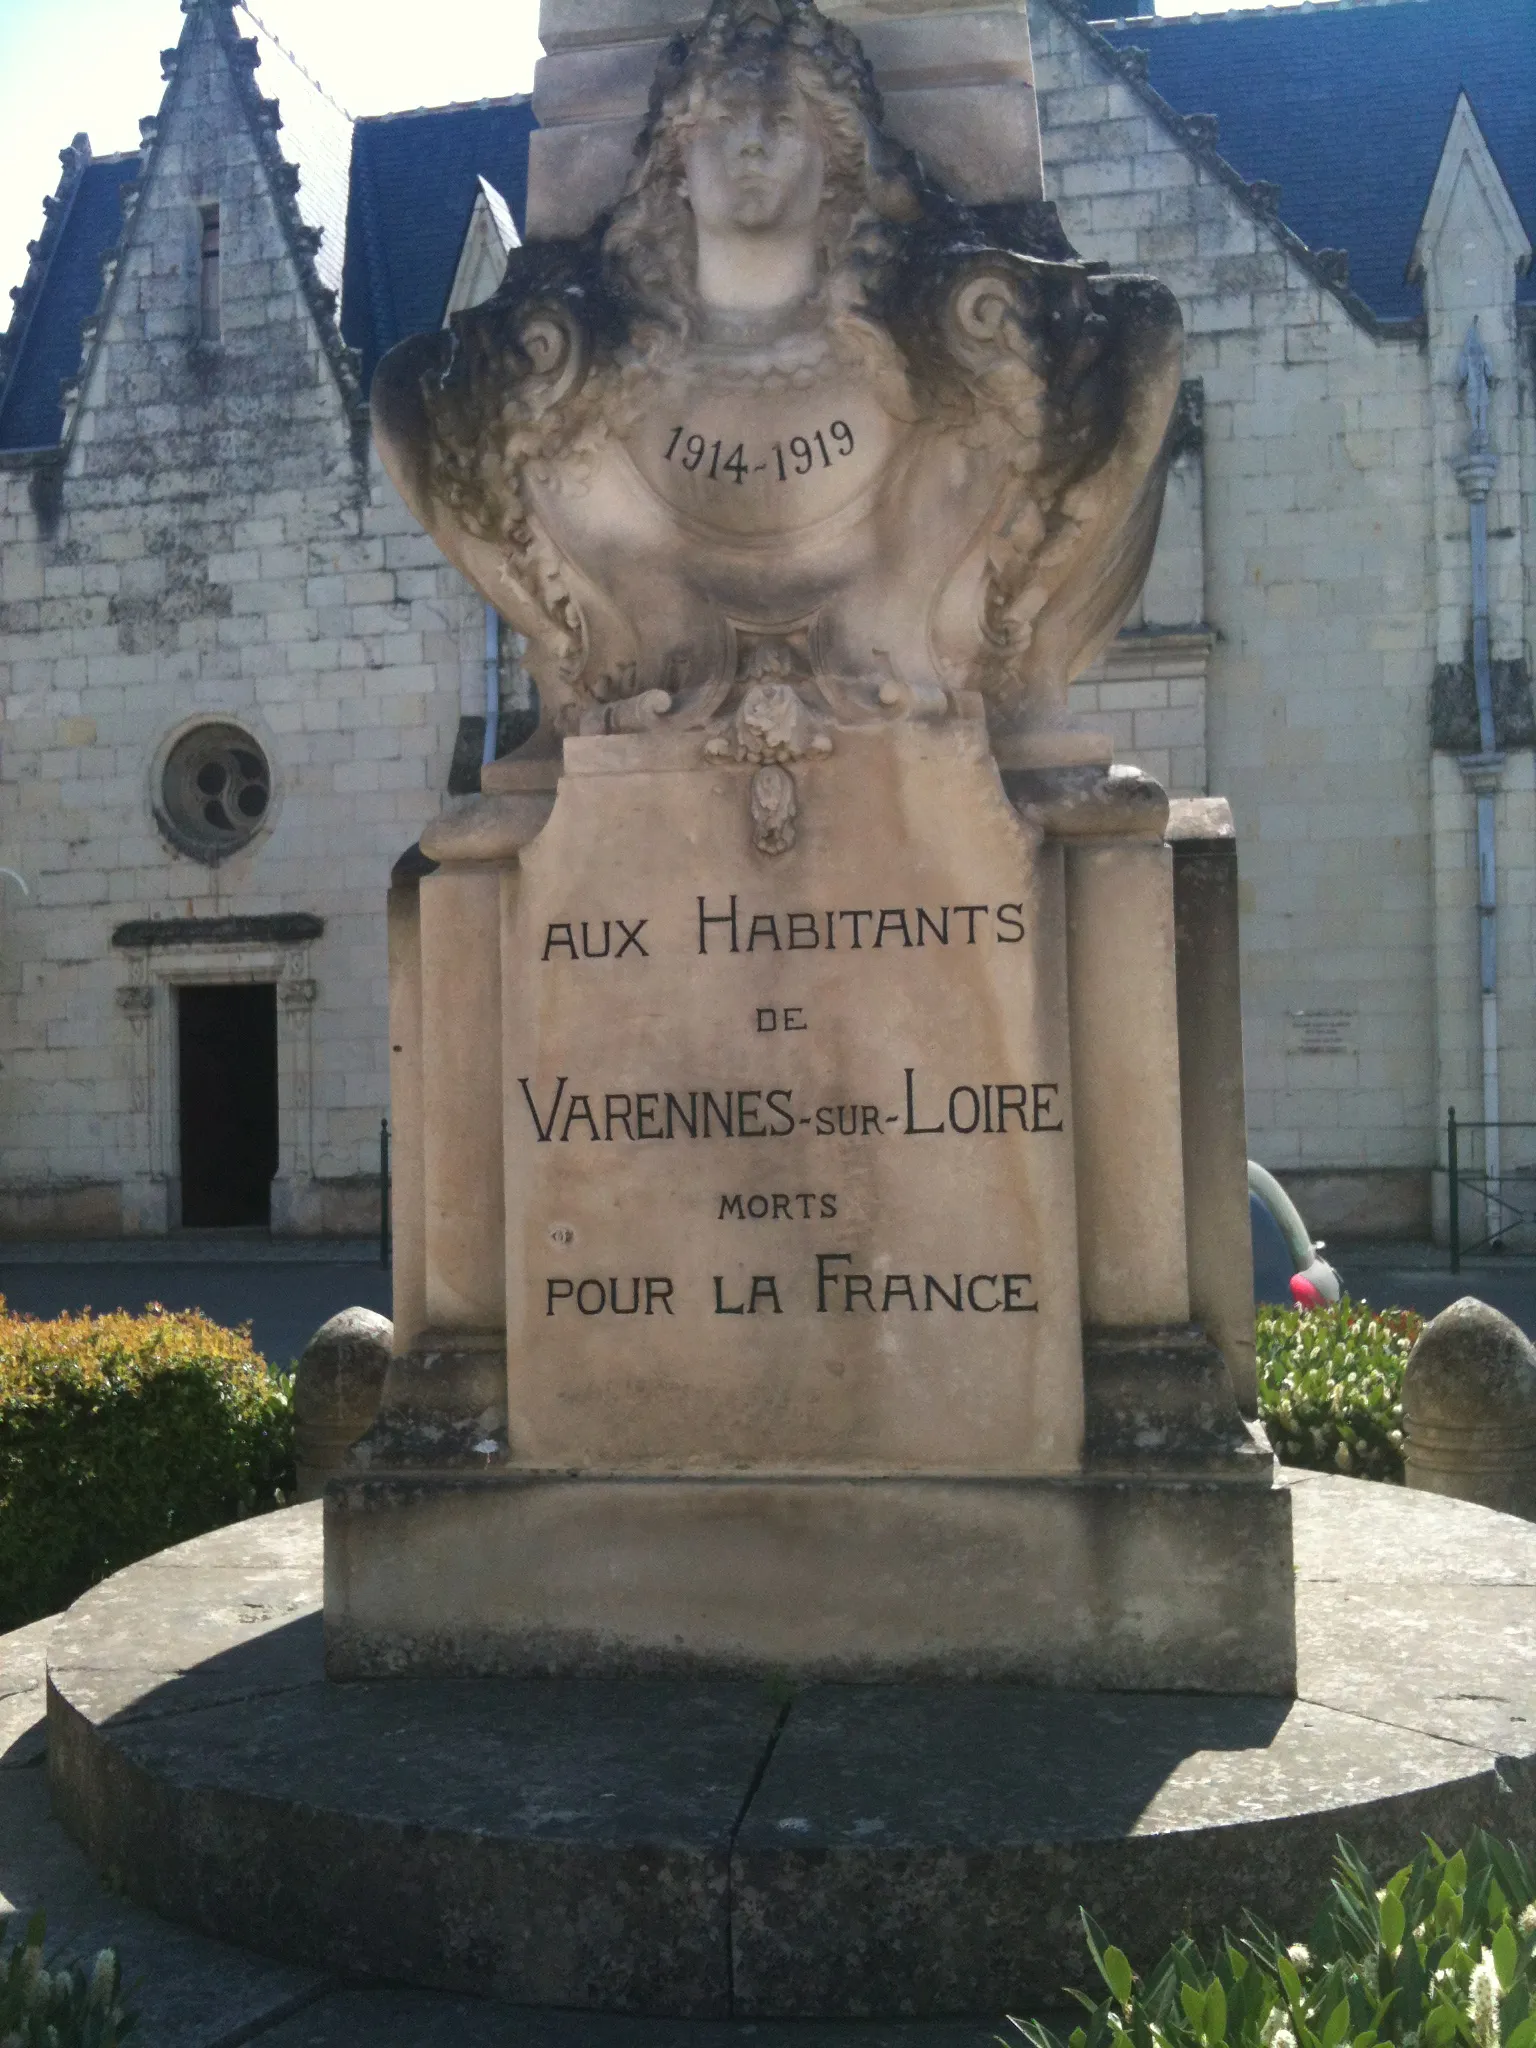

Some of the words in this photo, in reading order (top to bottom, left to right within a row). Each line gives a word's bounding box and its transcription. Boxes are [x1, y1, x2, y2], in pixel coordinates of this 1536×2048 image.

[540, 914, 650, 962] AUX
[696, 894, 1026, 956] HABITANTS
[755, 1007, 809, 1033] DE
[517, 1067, 1065, 1143] VARENNES-SUR-LOIRE
[716, 1192, 839, 1220] MORTS
[545, 1276, 675, 1317] POUR
[712, 1275, 783, 1316] LA
[814, 1253, 1040, 1314] FRANCE
